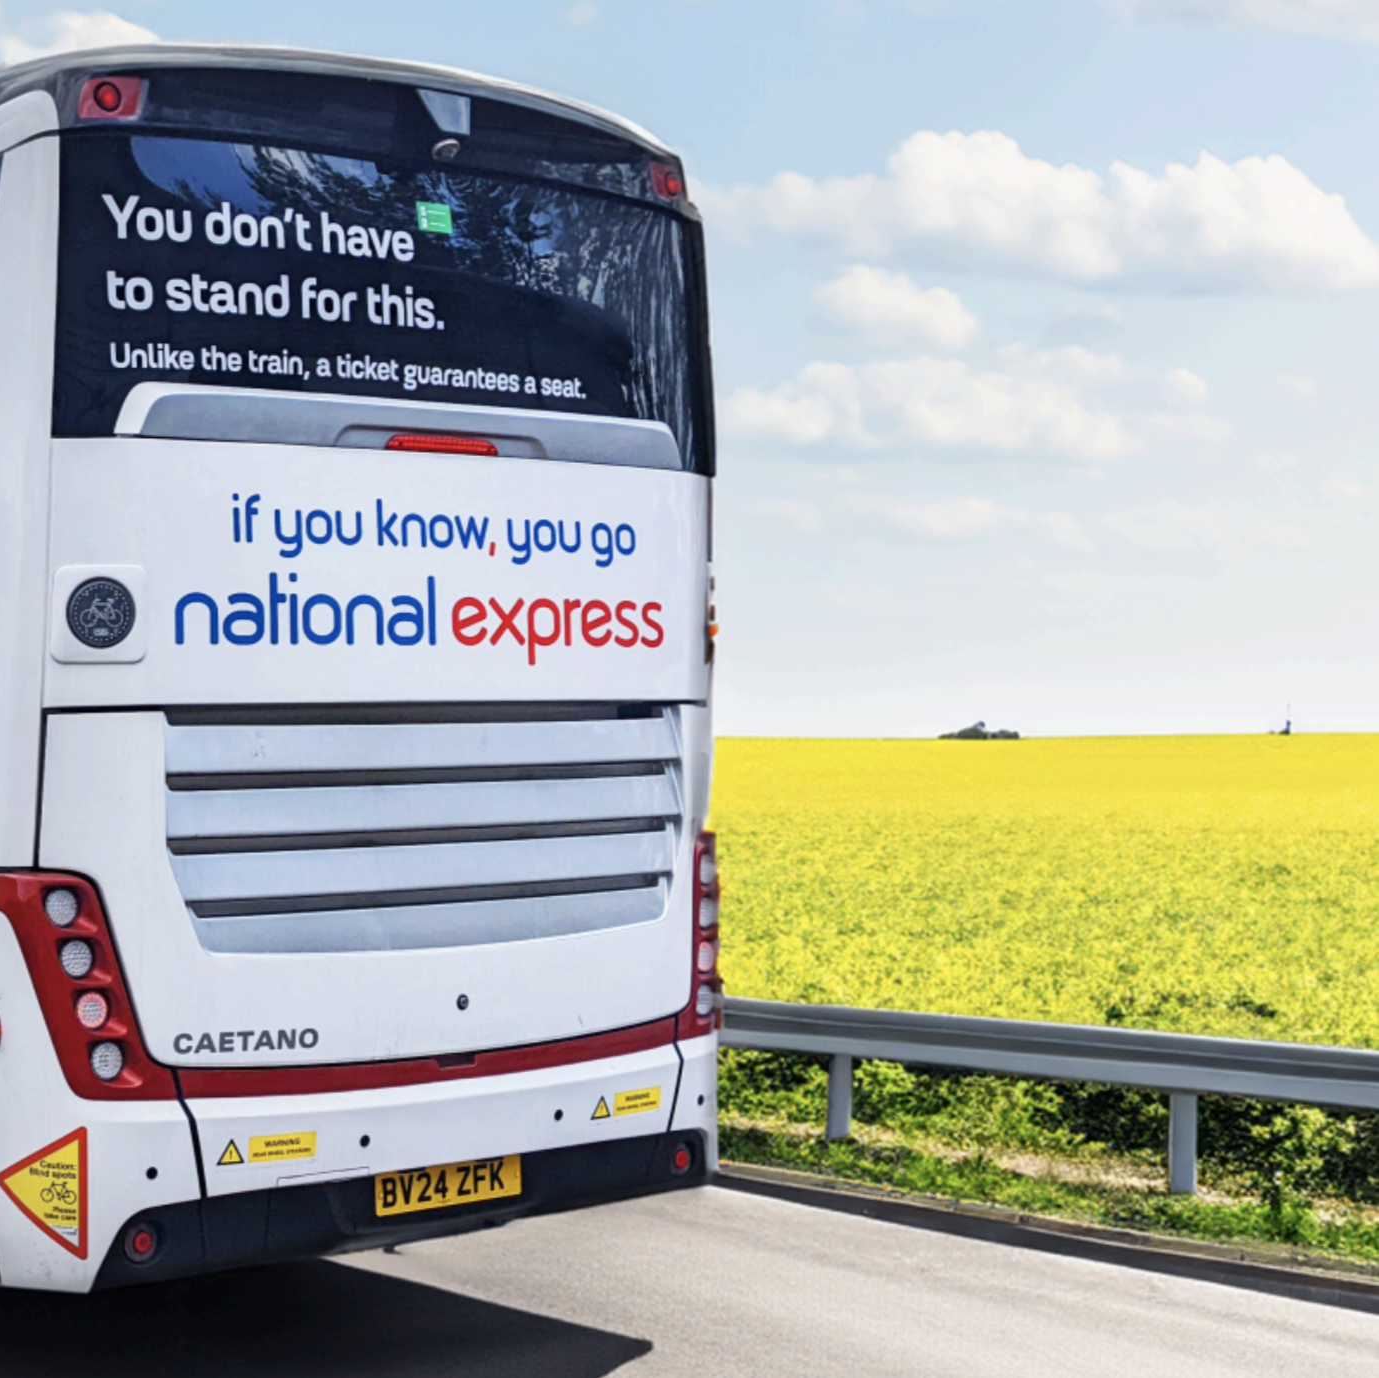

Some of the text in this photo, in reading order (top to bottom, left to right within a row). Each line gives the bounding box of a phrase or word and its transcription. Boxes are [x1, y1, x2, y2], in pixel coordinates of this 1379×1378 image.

[101, 194, 415, 262] You don’t have
[106, 270, 445, 330] to stand for this.
[109, 342, 587, 399] Unlike the train, a ticket guarantees a seat.
[231, 492, 637, 569] if you know, you go
[174, 571, 664, 666] national express
[173, 1028, 319, 1055] CAETANO
[40, 1160, 77, 1170] Caution:
[264, 1138, 301, 1147] WARNING
[30, 1166, 76, 1179] Blind spots
[381, 1160, 506, 1209] BV24 ZFK
